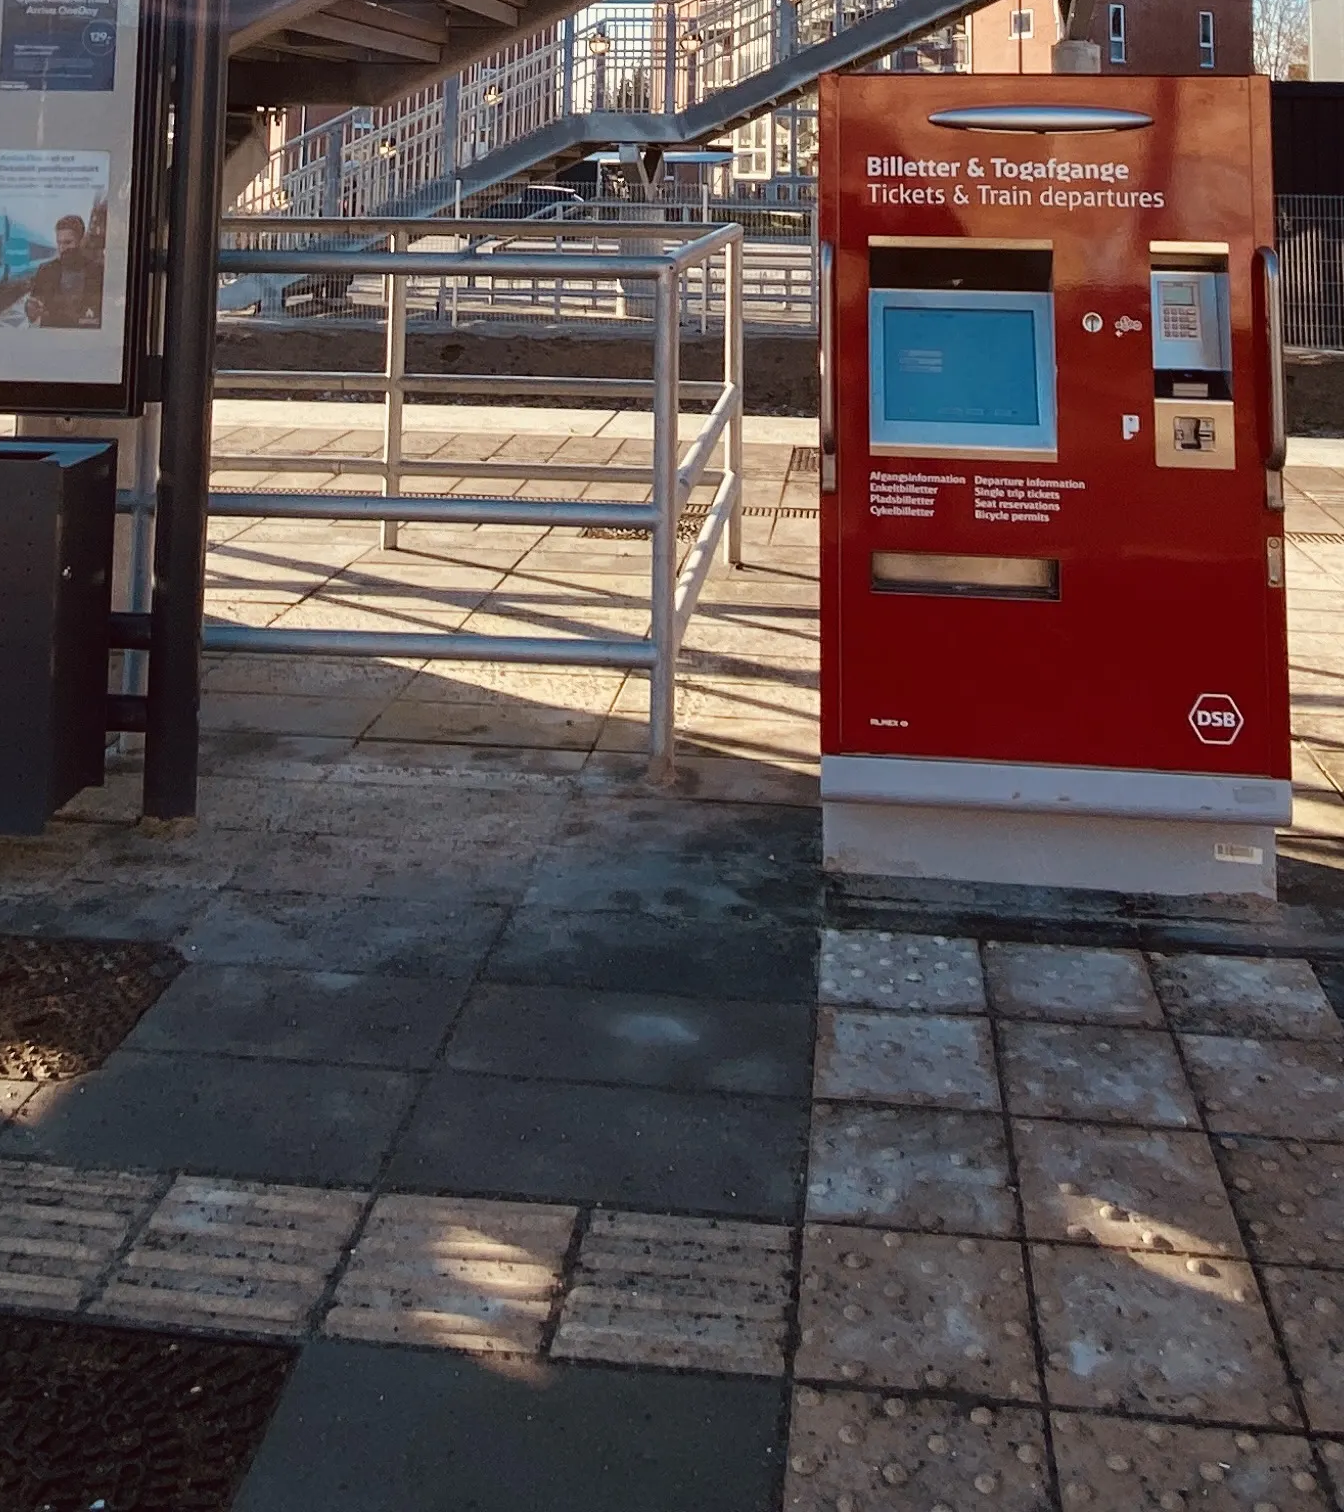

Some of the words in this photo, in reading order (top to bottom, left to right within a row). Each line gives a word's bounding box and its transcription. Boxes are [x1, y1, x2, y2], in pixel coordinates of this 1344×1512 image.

[867, 156, 960, 177] Billetter
[967, 157, 985, 177] &
[990, 158, 1129, 182] Togafgange
[867, 184, 945, 205] Tickets
[953, 185, 969, 204] &
[977, 185, 1031, 205] Train
[1040, 187, 1165, 211] departures
[870, 471, 966, 485] Afgangsinformation
[974, 476, 1024, 488] Departure
[1026, 477, 1086, 489] information
[870, 483, 938, 495] Enkeltbilletter
[974, 487, 1005, 499] Single
[1007, 488, 1025, 500] trip
[1027, 489, 1060, 500] tickets
[870, 494, 935, 506] Pladsbilletter
[975, 498, 997, 508] Seat
[999, 500, 1060, 511] reservations
[870, 505, 935, 517] Cykelbilletter
[975, 510, 1010, 522] Bicycle
[1011, 511, 1050, 522] permits
[1196, 710, 1236, 728] DSB
